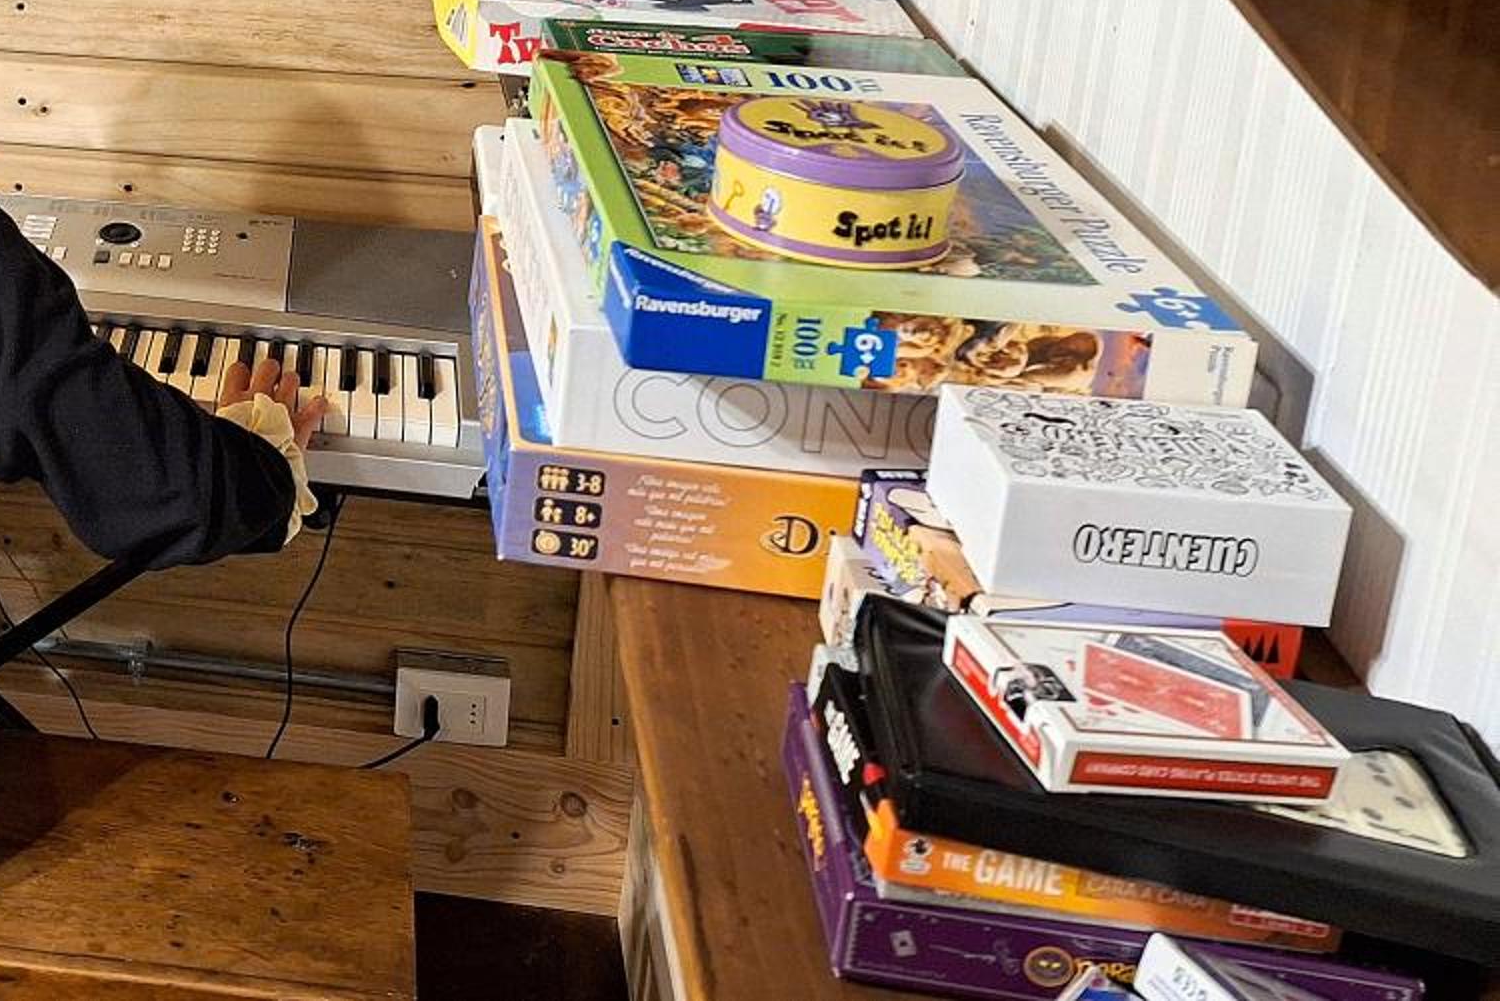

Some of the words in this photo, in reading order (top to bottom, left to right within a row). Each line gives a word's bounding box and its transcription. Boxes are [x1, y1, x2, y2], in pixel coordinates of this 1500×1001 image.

[765, 72, 853, 92] 100
[960, 113, 1082, 214] Ravensburger
[1060, 218, 1147, 275] Puzzle
[832, 210, 901, 246] Spot
[635, 295, 763, 324] Ravensburger
[792, 317, 823, 357] 100
[855, 333, 884, 365] 6+
[576, 472, 602, 494] 3-8
[574, 505, 596, 523] 8+
[1073, 524, 1260, 577] CUENTERO
[942, 852, 972, 872] THE
[974, 849, 1065, 896] GAME
